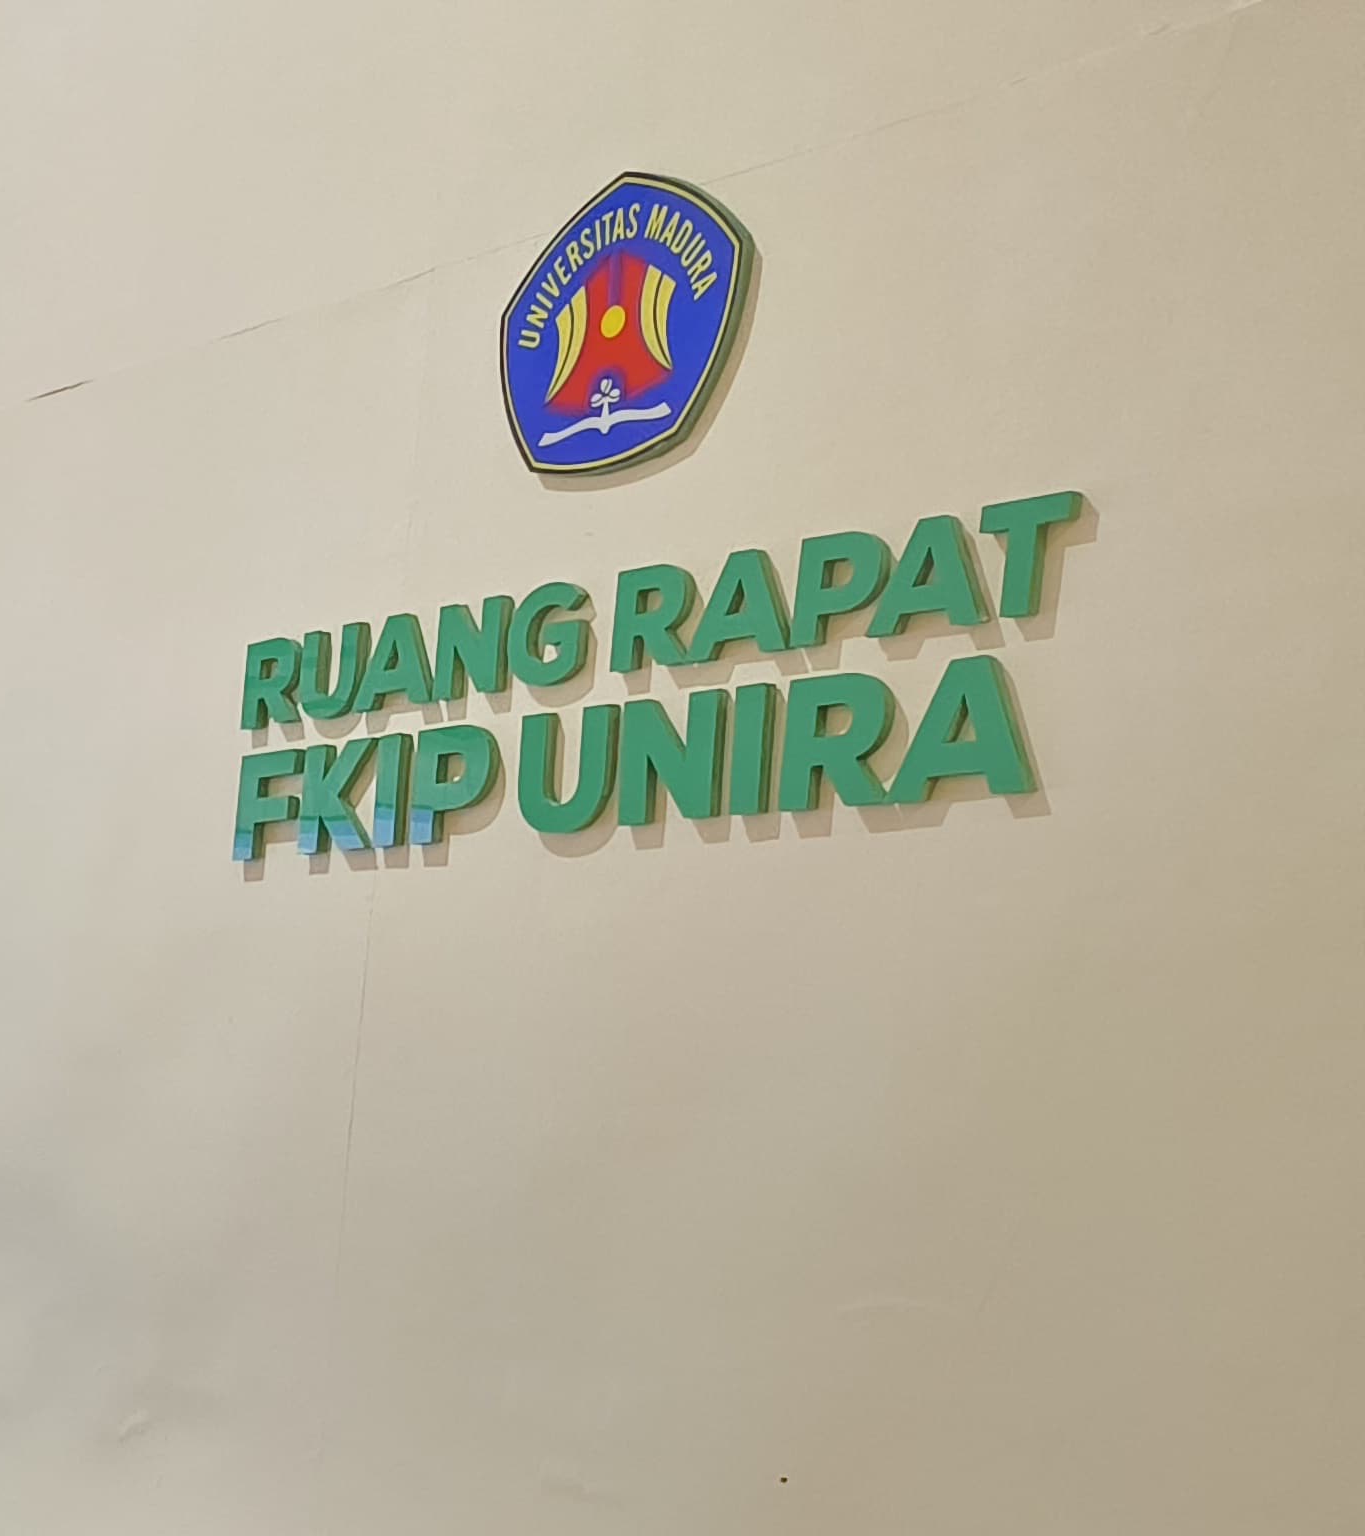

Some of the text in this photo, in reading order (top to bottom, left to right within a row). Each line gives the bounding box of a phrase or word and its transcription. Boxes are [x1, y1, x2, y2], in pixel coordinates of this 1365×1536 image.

[518, 202, 718, 349] UNIVERSITAS MADURA
[240, 490, 1082, 730] RUANG RAPAT
[232, 654, 1039, 863] FKIP UNIRA
